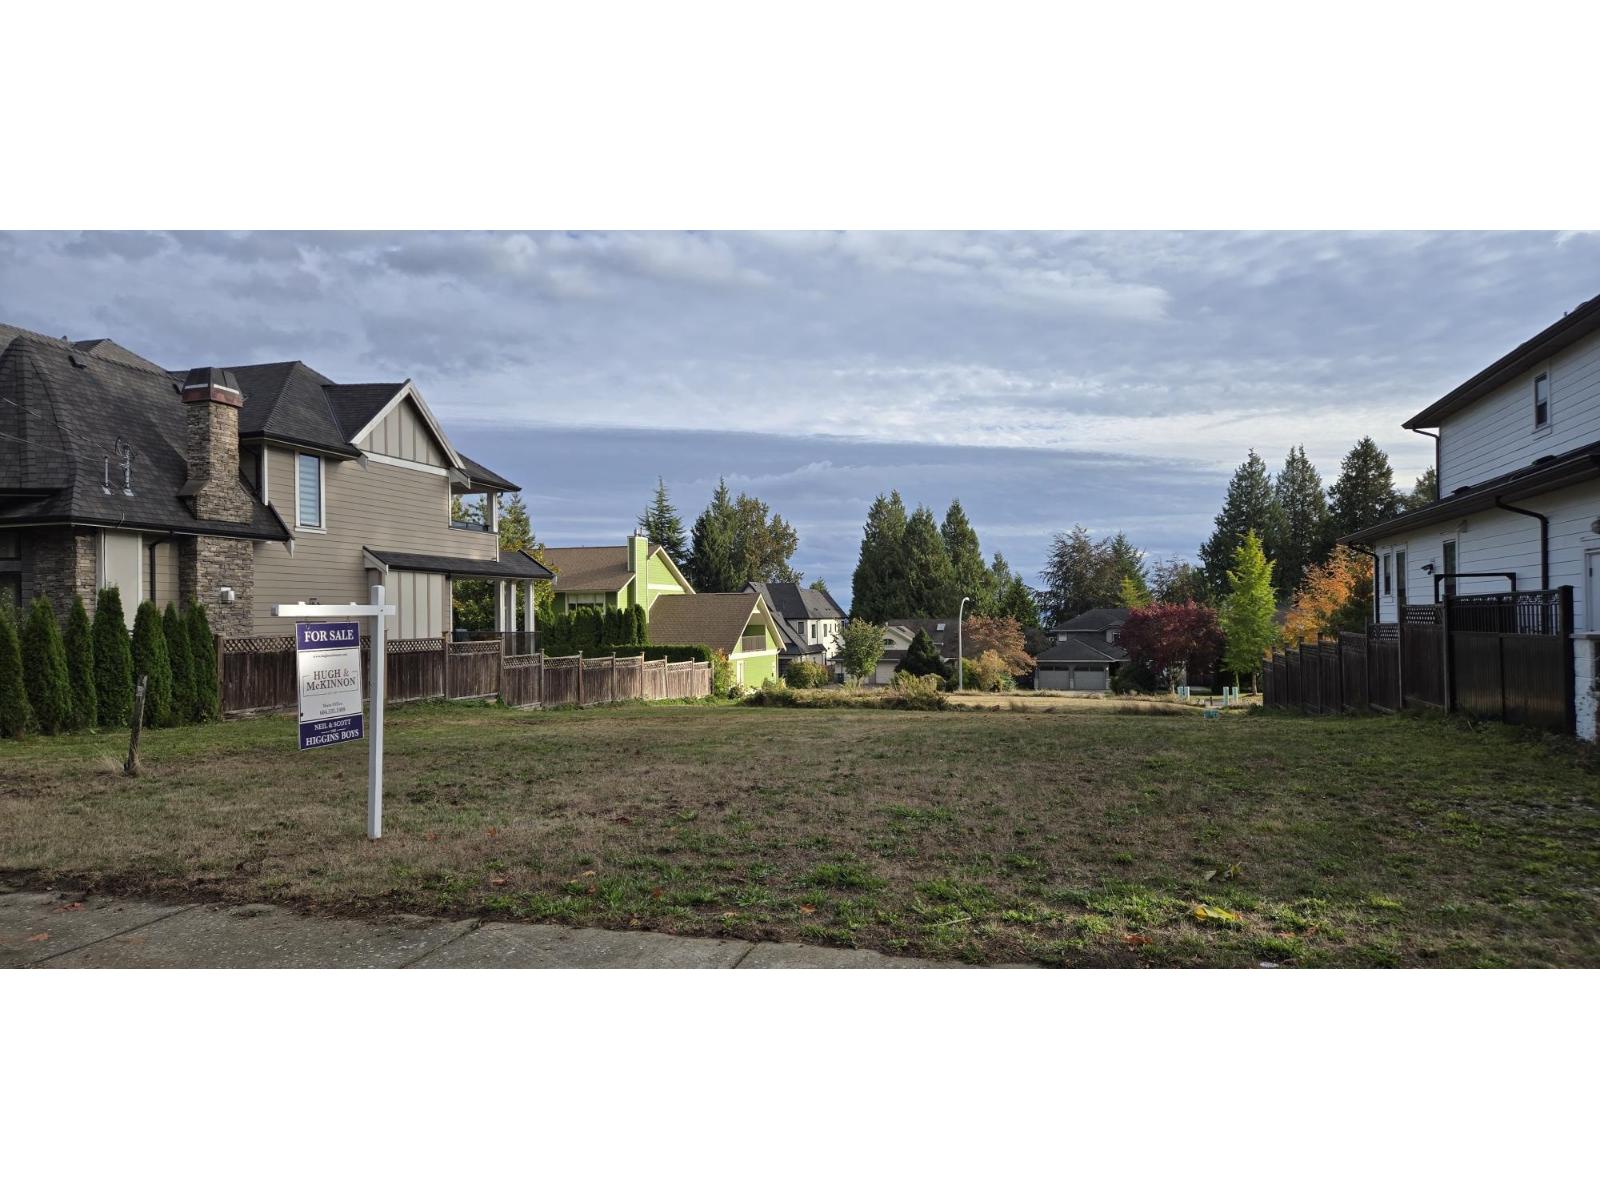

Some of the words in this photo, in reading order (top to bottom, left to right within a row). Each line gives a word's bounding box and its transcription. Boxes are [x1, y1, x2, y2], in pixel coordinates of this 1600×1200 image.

[304, 630, 328, 643] FOR
[329, 629, 354, 641] SALE
[313, 669, 341, 680] HUGH
[343, 668, 350, 677] &
[306, 676, 356, 691] McKINNON
[314, 723, 328, 731] NEIL
[333, 718, 352, 728] SCOTT
[306, 733, 339, 746] HIGGINS
[341, 729, 359, 740] BOYS
